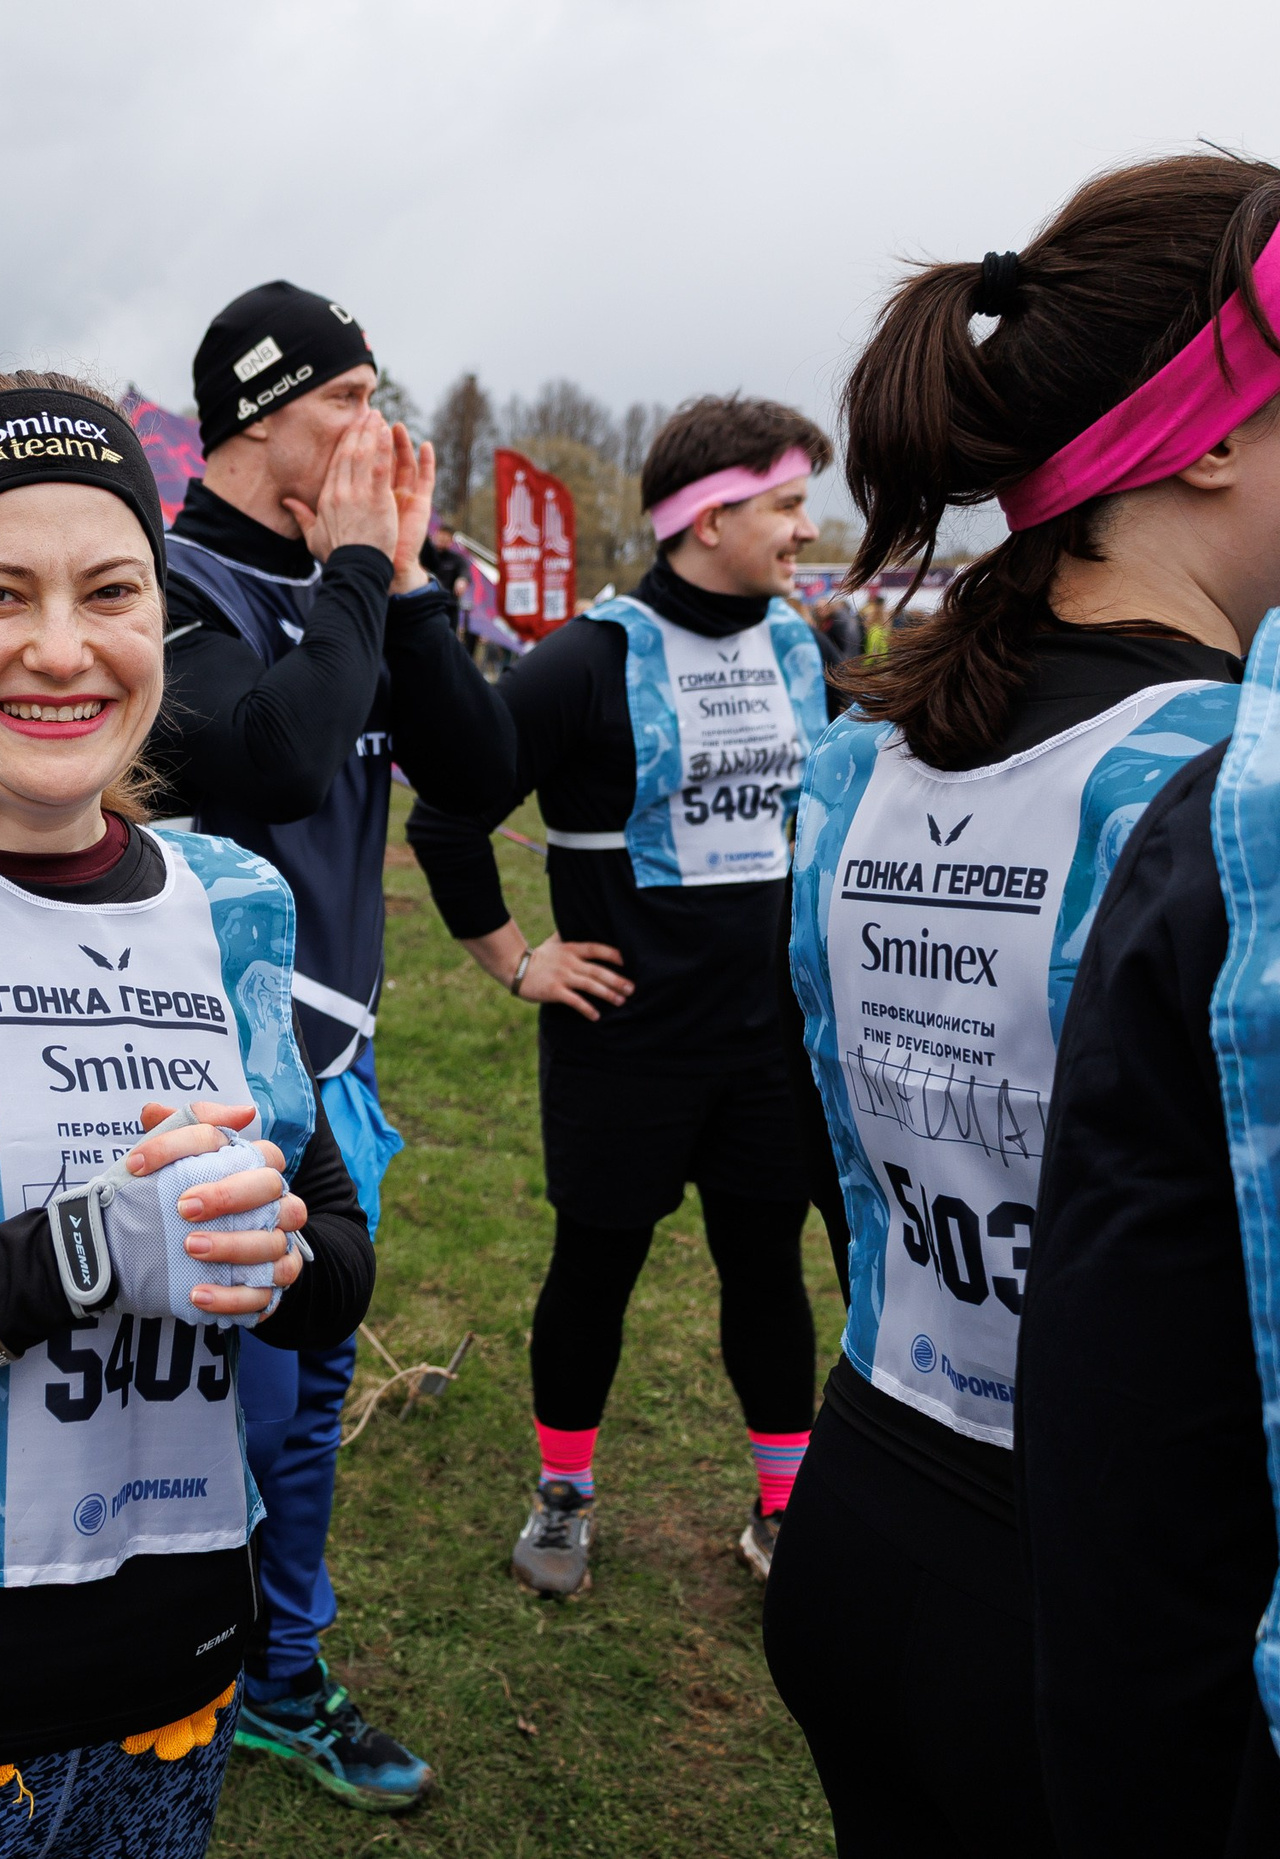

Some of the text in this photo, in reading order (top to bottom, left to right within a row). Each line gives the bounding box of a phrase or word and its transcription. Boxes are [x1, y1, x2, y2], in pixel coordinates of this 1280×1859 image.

[240, 344, 274, 378] DNB
[10, 437, 98, 460] team
[678, 668, 776, 687] ГОНКА ГЕРОЕВ
[699, 694, 771, 719] Sminex
[843, 859, 1049, 900] ГОНКА ГЕРОЕВ
[860, 922, 999, 988] Sminex
[118, 985, 226, 1023] ГЕРОЕВ
[861, 1000, 996, 1039] ПЕРФЕКЦИОНИСТЫ
[863, 1026, 996, 1067] FINE DEVELOPMENT
[41, 1042, 220, 1093] Sminex
[61, 1149, 105, 1165] FINE
[73, 1232, 92, 1286] DEMIX
[112, 1477, 209, 1519] ГПРОМБАНК
[195, 1624, 237, 1656] DEMIX
